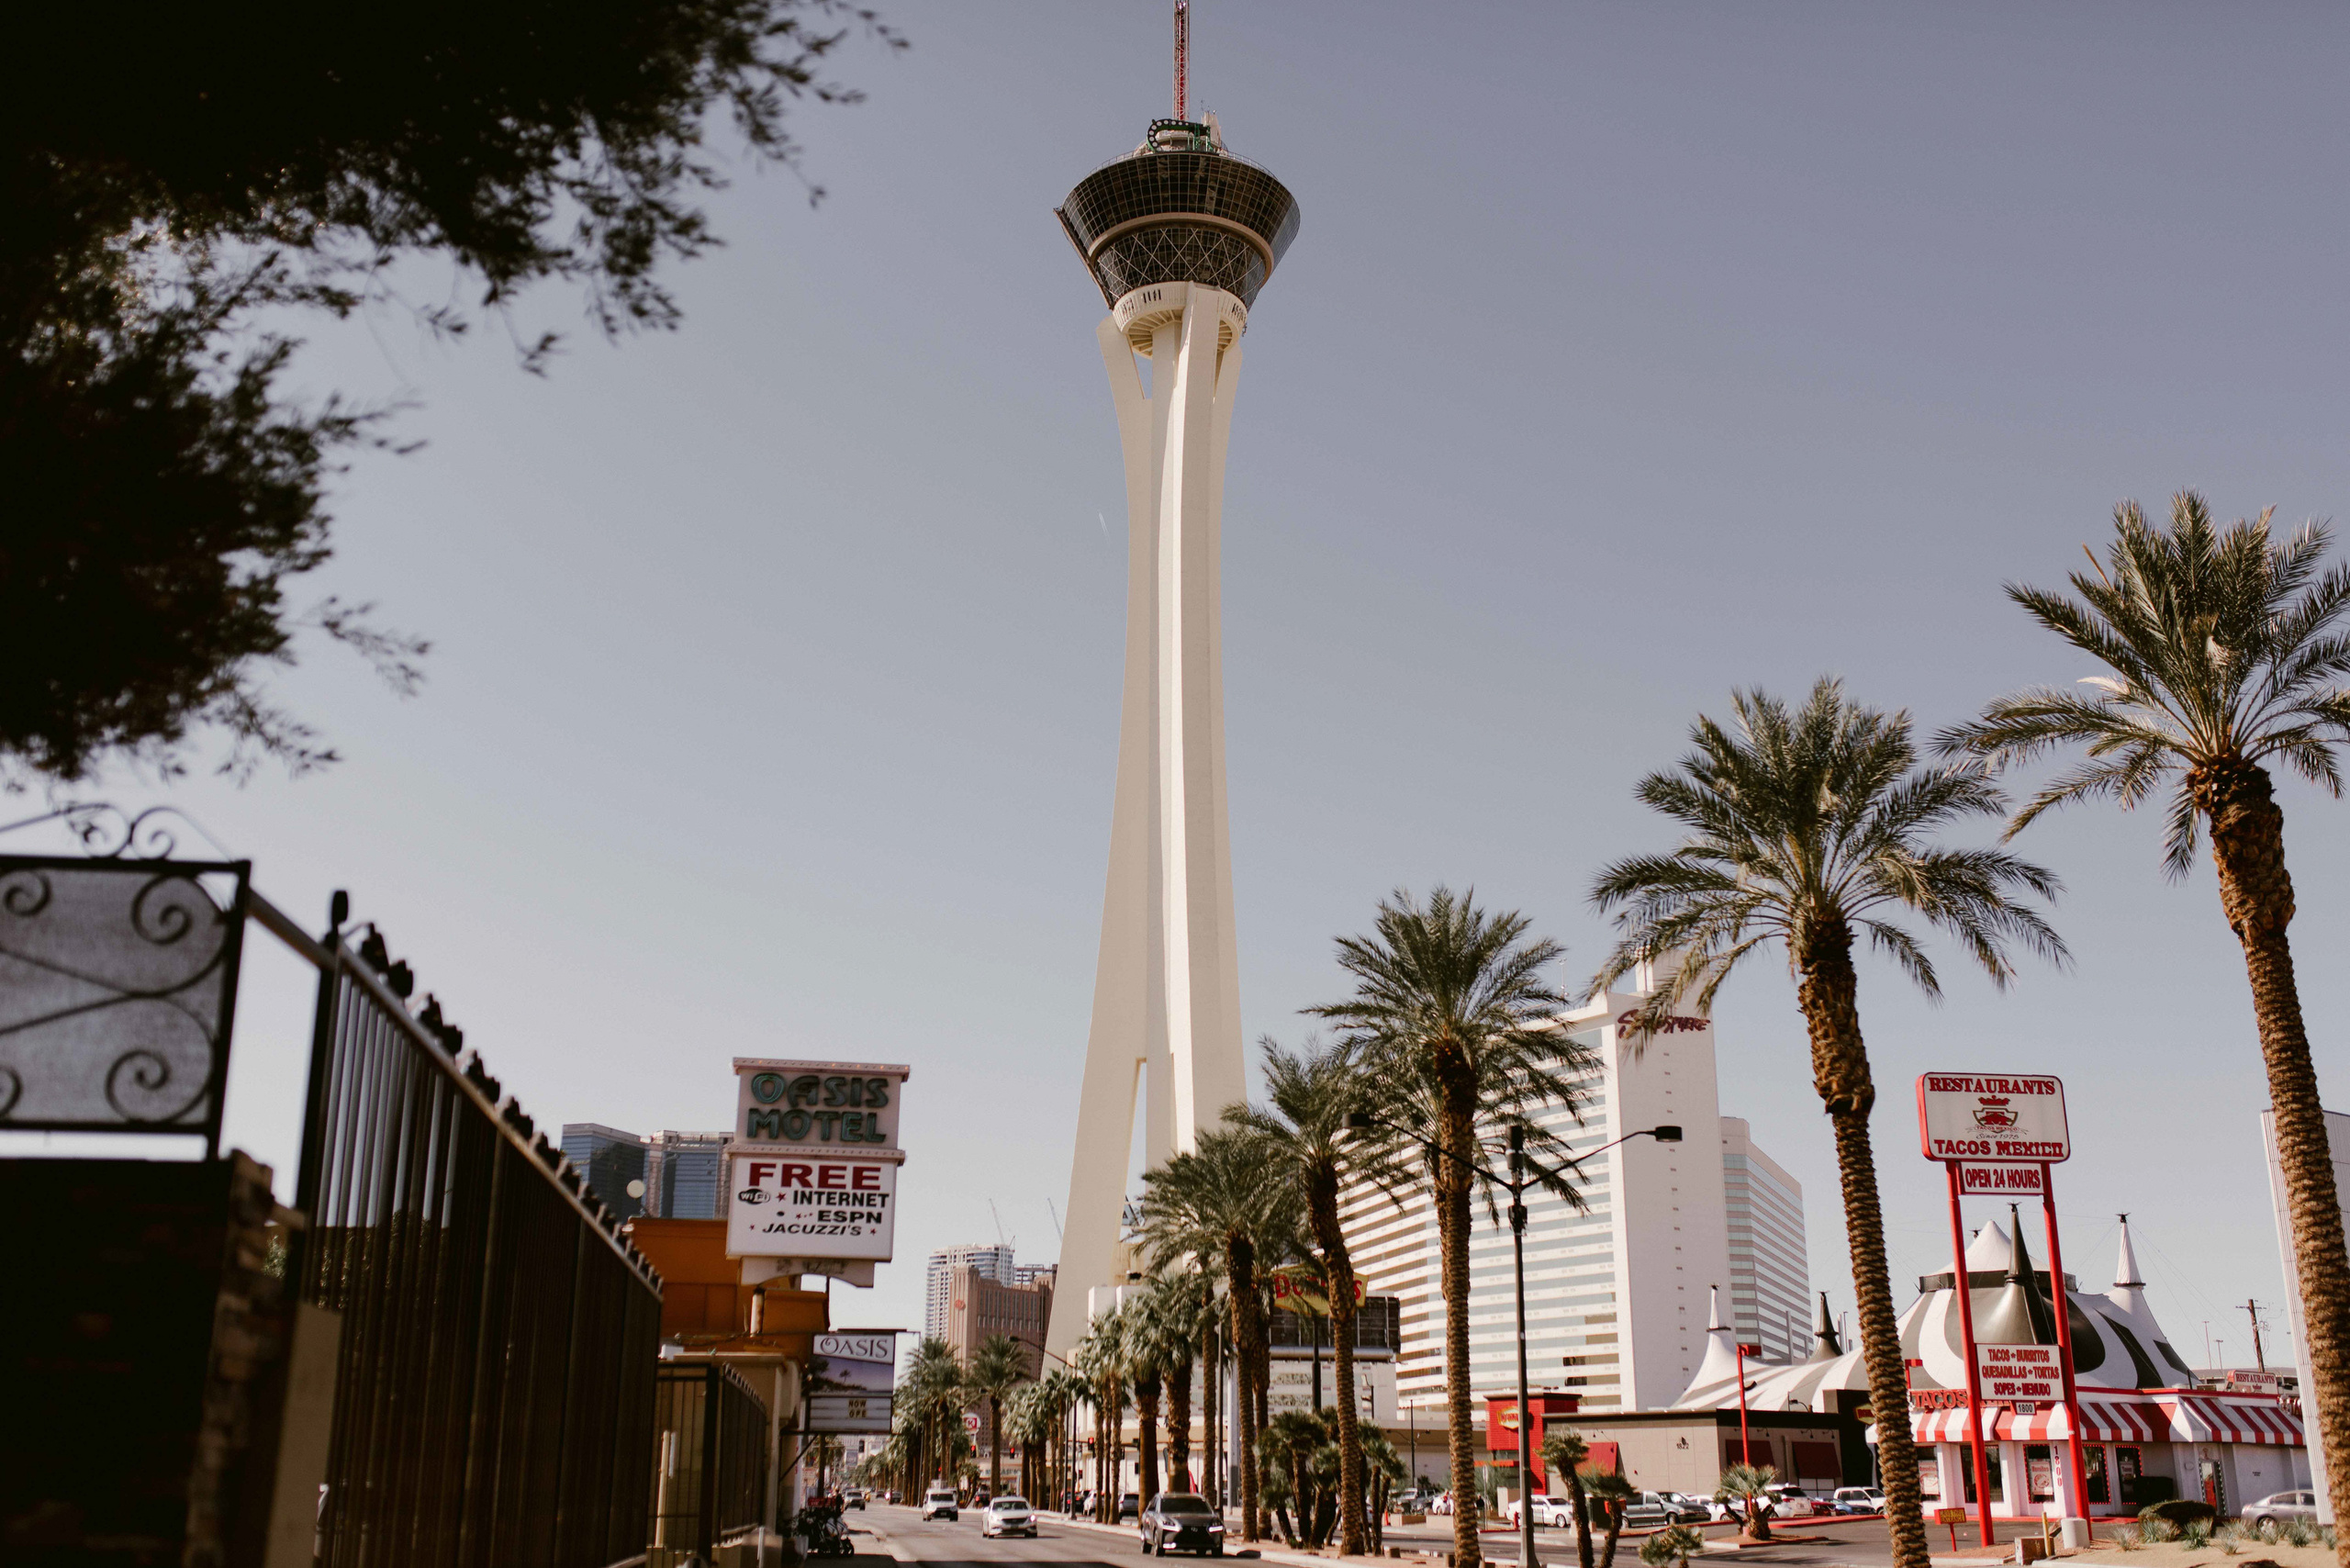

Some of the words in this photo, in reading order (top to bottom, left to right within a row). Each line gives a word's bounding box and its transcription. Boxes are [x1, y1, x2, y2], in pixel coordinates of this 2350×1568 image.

[751, 1072, 889, 1108] OASIS
[1928, 1077, 2055, 1095] RESTAURANTS
[746, 1107, 887, 1142] MOTEL
[1934, 1139, 1991, 1155] TACOS
[1996, 1141, 2065, 1158] MEXICO
[748, 1162, 881, 1191] FREE
[1964, 1168, 1992, 1188] OPEN
[1993, 1169, 2006, 1188] 24
[2007, 1169, 2041, 1189] HOURS
[792, 1190, 890, 1208] INTERNET
[817, 1210, 882, 1224] ESPN
[762, 1223, 862, 1237] JACUZZI'S
[1987, 1349, 2010, 1362] TACOS
[2016, 1350, 2050, 1363] BURRITOS
[1982, 1366, 2027, 1380] QUESADILLAS
[2032, 1366, 2060, 1380] TORTAS
[2235, 1373, 2276, 1384] RESTAURANTS
[1993, 1383, 2016, 1395] SOPES
[2021, 1383, 2051, 1396] MENUDO
[1911, 1390, 1968, 1409] TACOS
[2018, 1404, 2033, 1413] 1800
